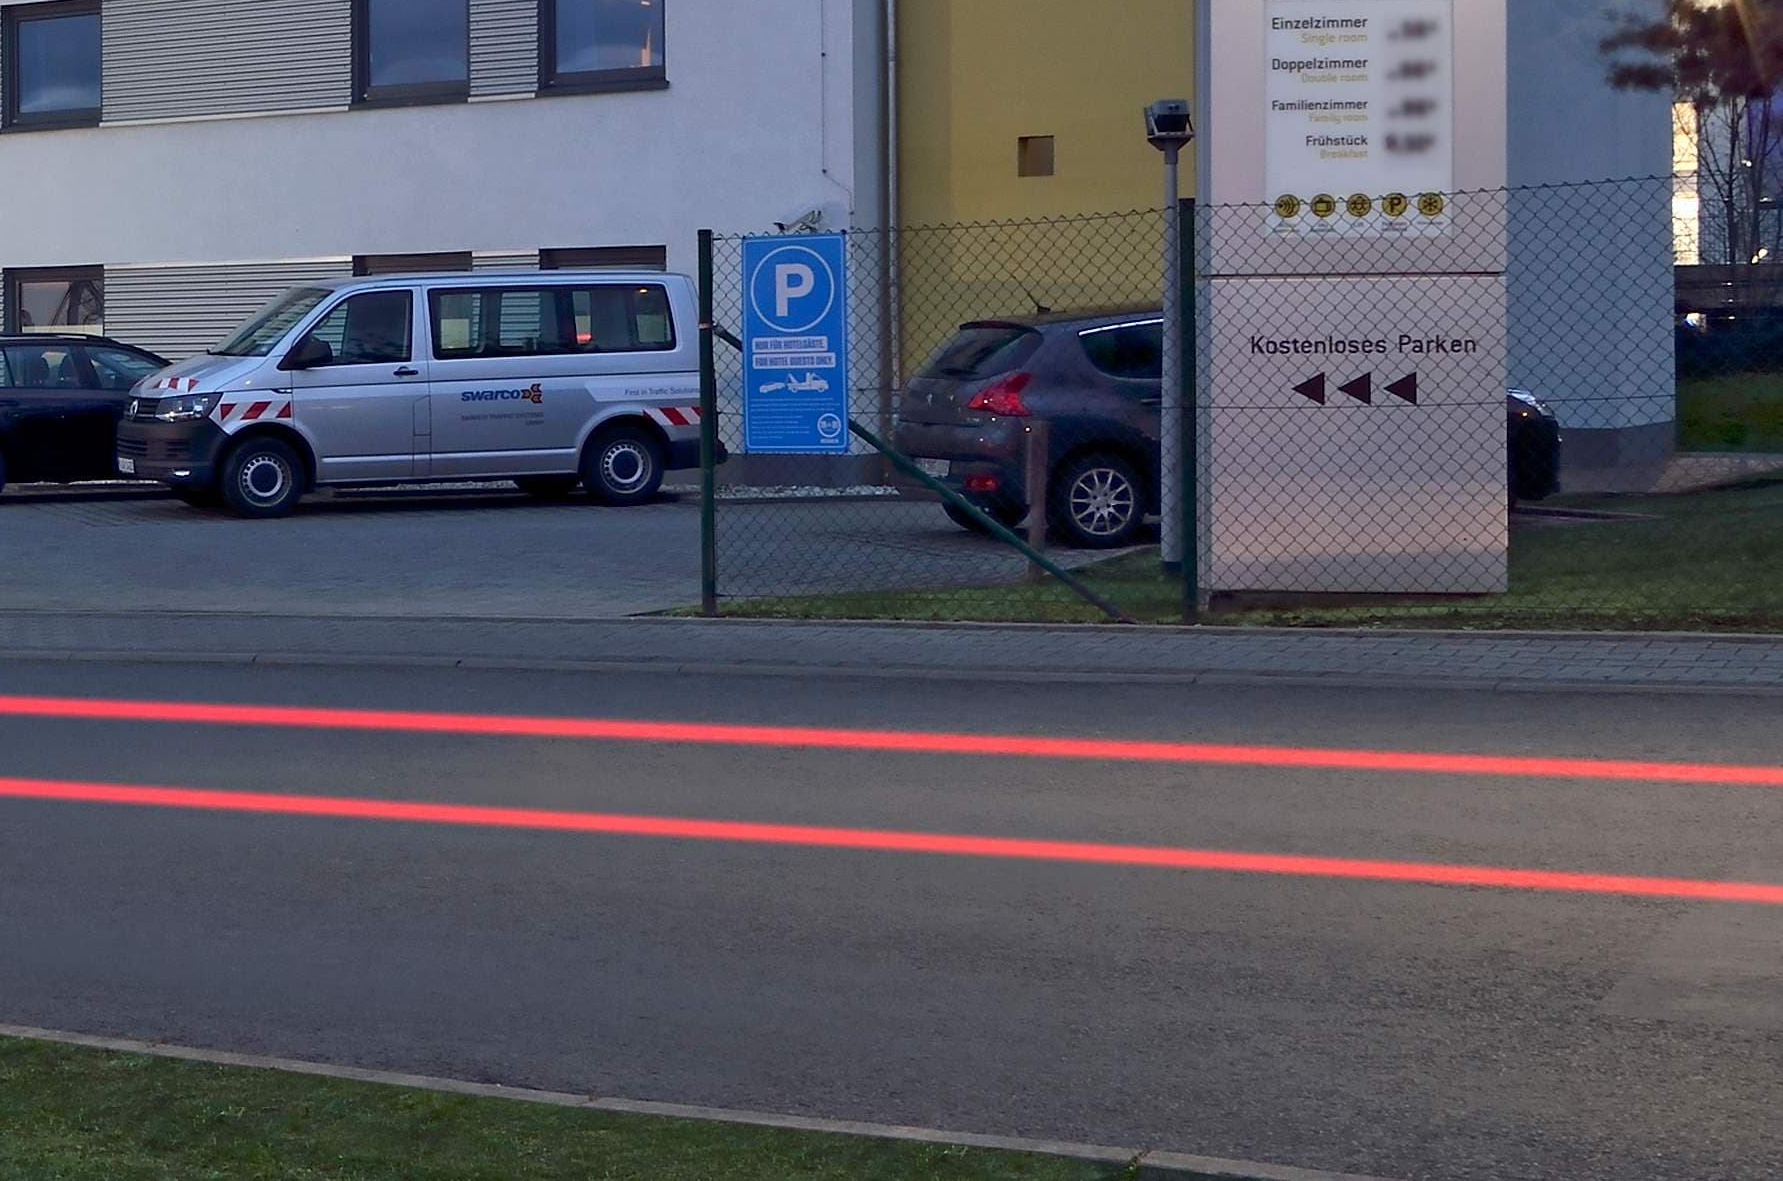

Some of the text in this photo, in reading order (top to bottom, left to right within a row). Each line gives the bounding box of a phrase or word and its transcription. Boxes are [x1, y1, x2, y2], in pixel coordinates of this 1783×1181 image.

[1271, 16, 1368, 30] Einzelzimmer
[1301, 33, 1368, 46] Single room
[1271, 58, 1368, 73] Doppelzimmer
[1271, 99, 1368, 111] Familienzimmer
[1305, 134, 1368, 147] Frühstück
[775, 263, 815, 317] P
[1250, 335, 1477, 354] Kostenloses Parken
[461, 389, 521, 401] swarco
